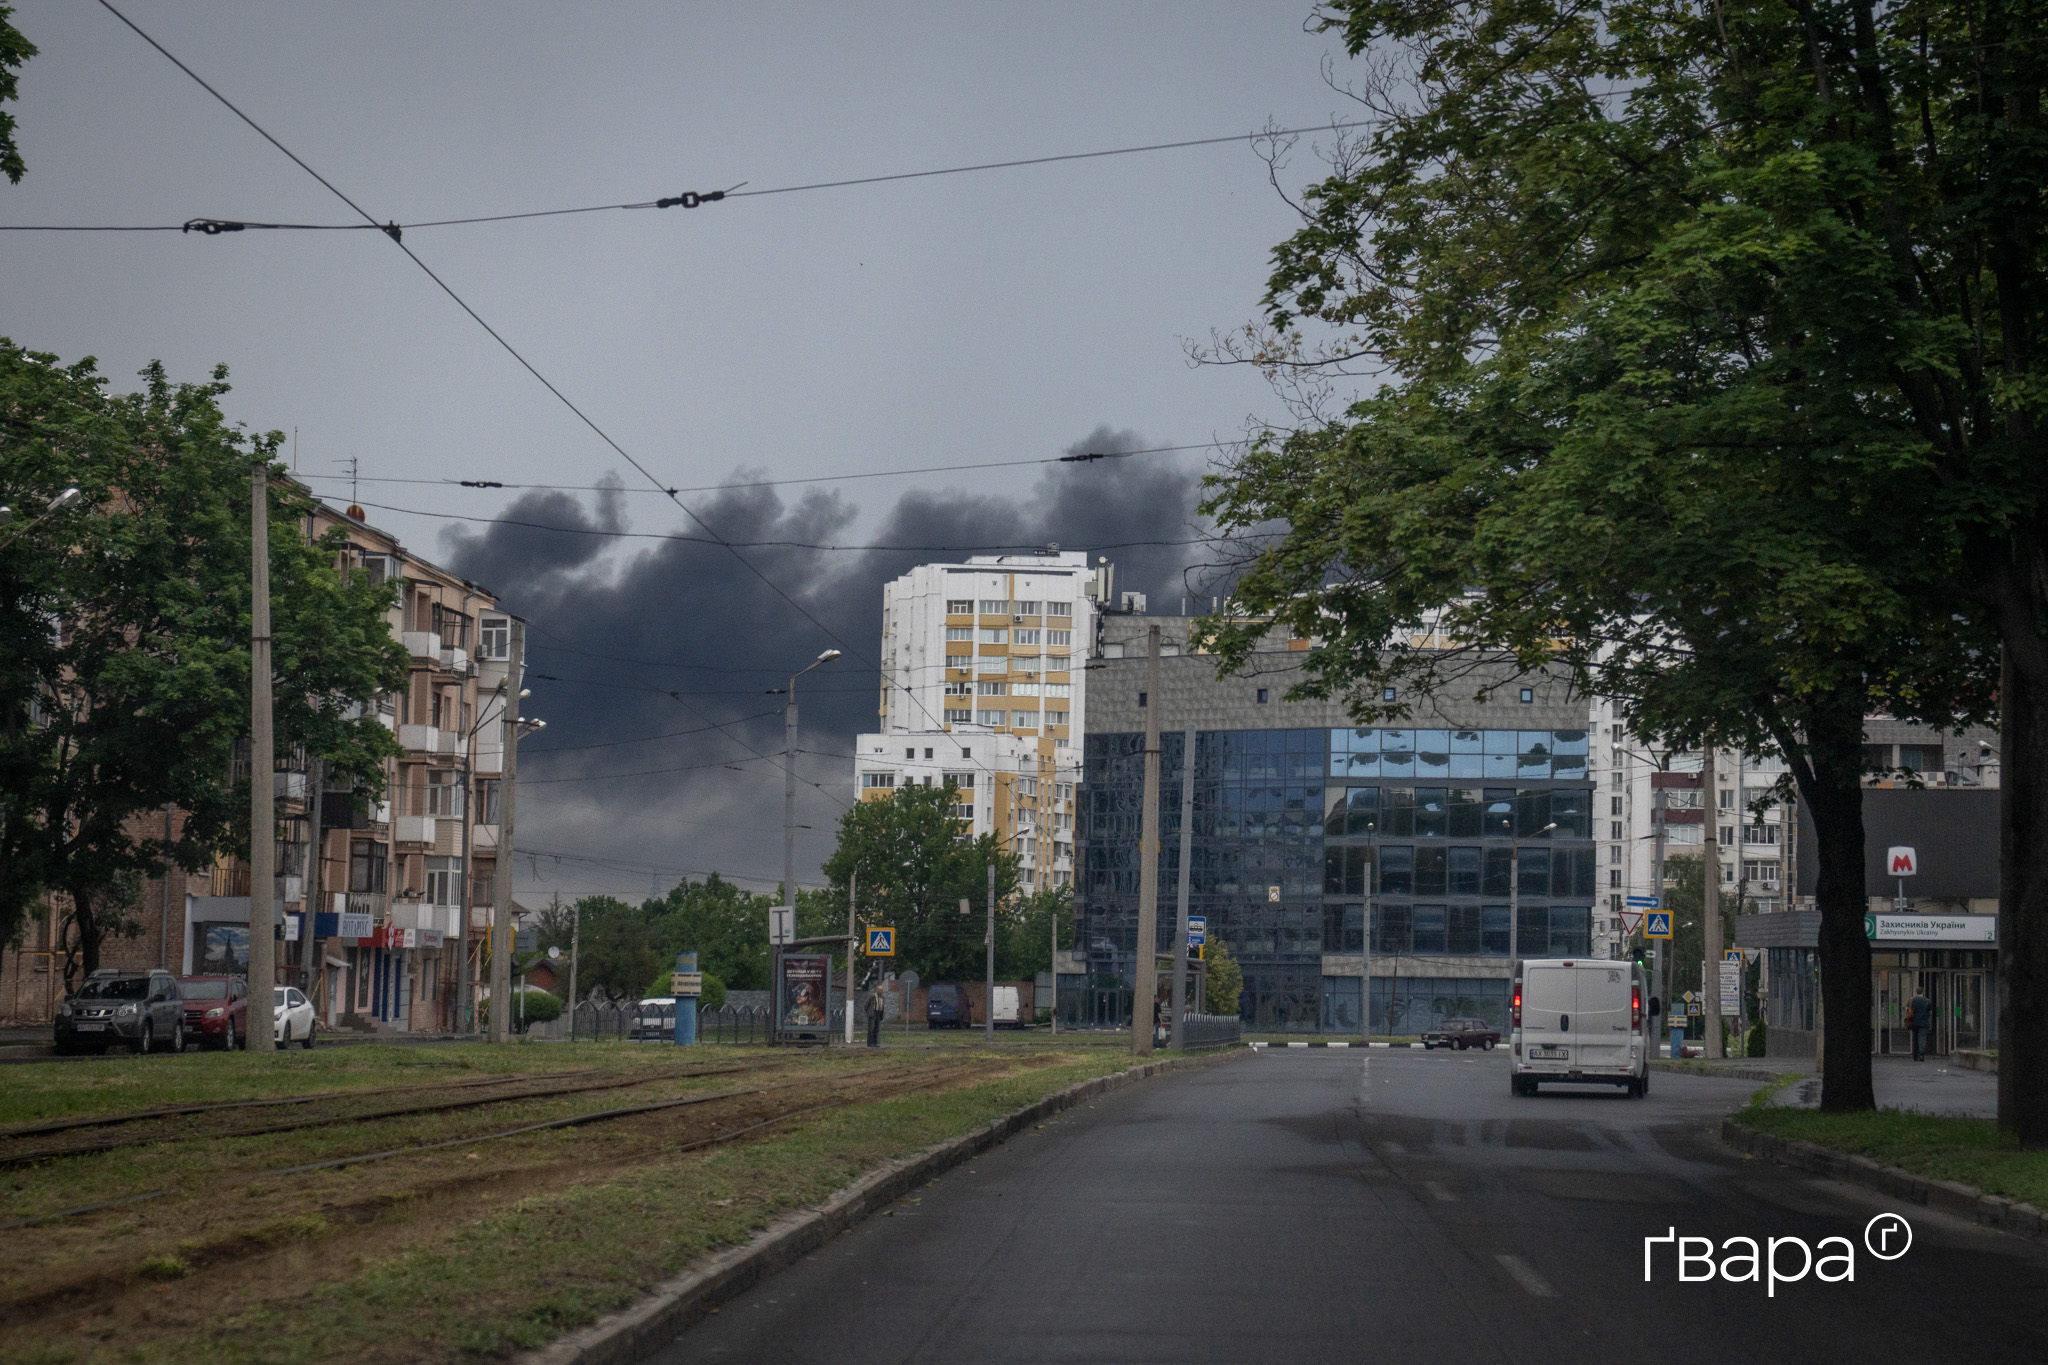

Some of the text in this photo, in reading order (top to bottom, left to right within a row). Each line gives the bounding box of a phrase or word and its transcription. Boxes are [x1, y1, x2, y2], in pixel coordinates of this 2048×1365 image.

[1893, 854, 1912, 872] М
[1880, 920, 1966, 931] Захисників України
[1987, 932, 1993, 940] 2
